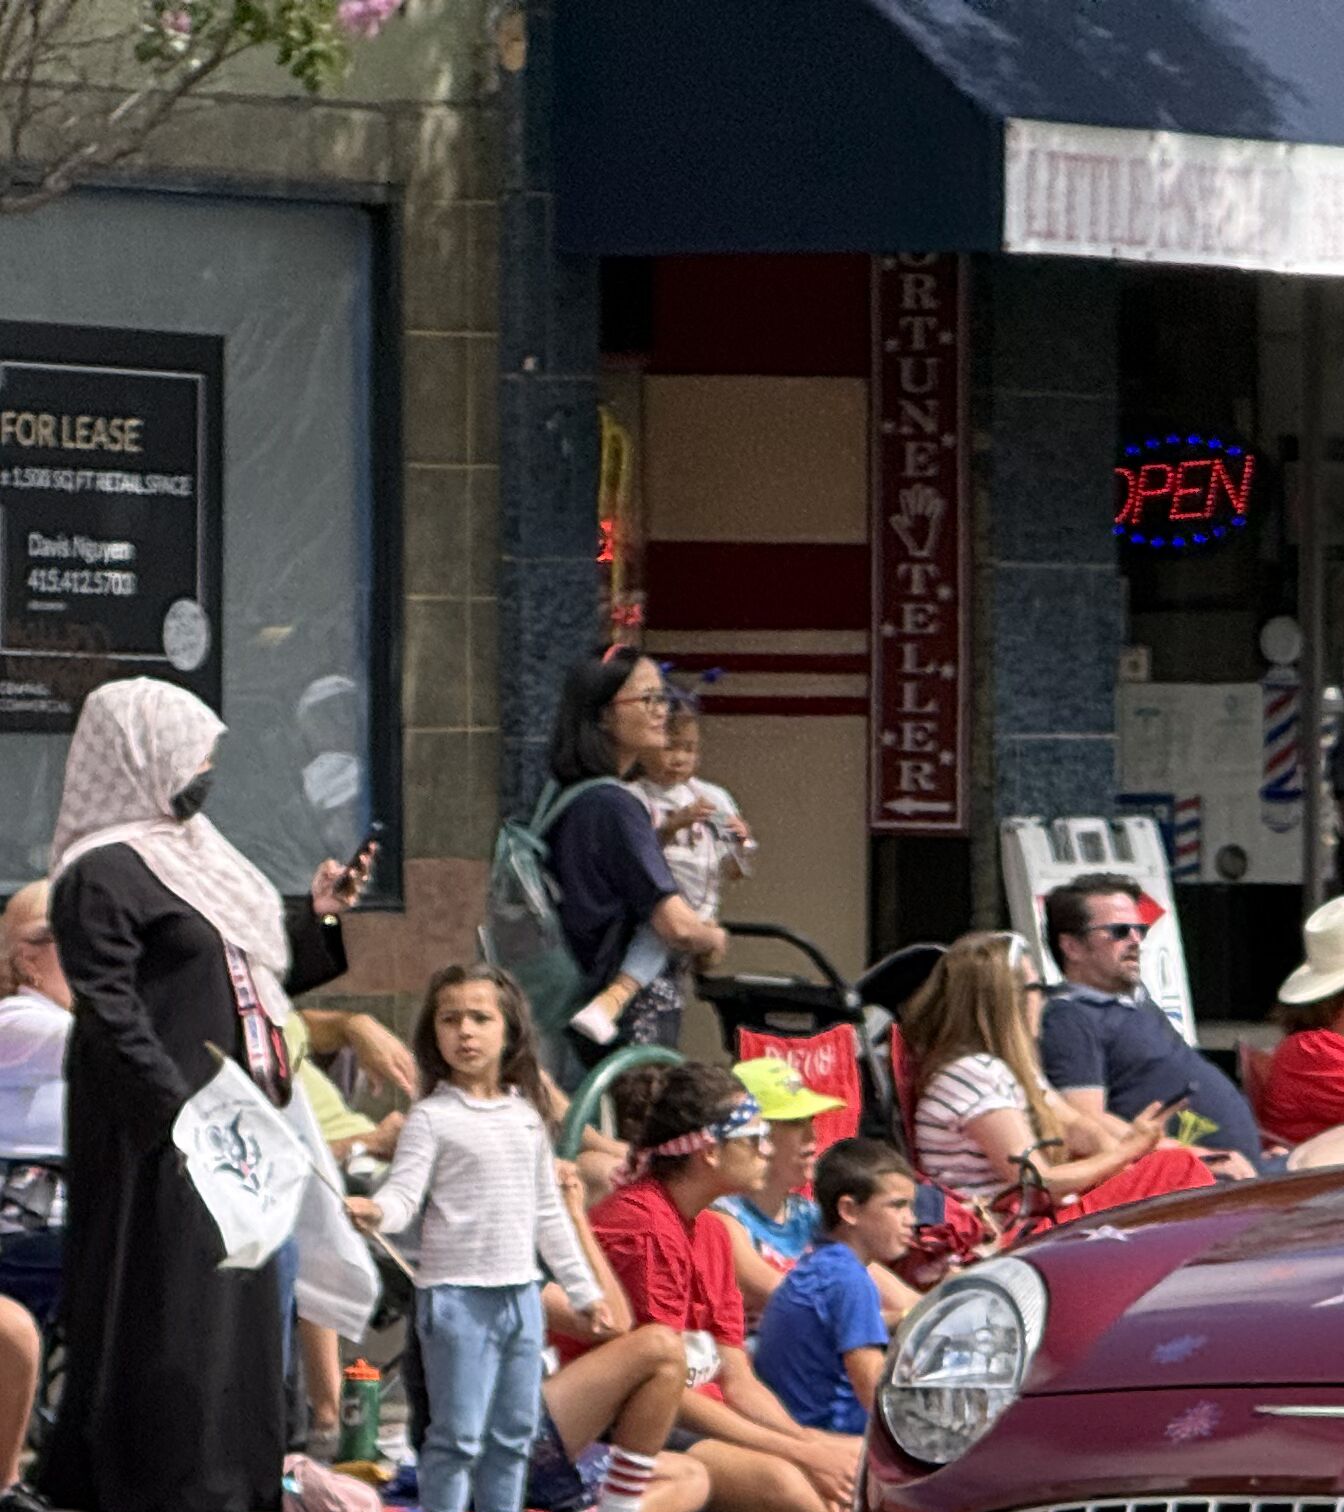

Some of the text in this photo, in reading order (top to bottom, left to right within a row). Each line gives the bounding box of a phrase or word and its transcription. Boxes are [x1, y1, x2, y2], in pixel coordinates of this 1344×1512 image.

[1, 411, 145, 452] FOR LEASE
[899, 250, 940, 477] RTUNE
[898, 563, 941, 791] TELLER
